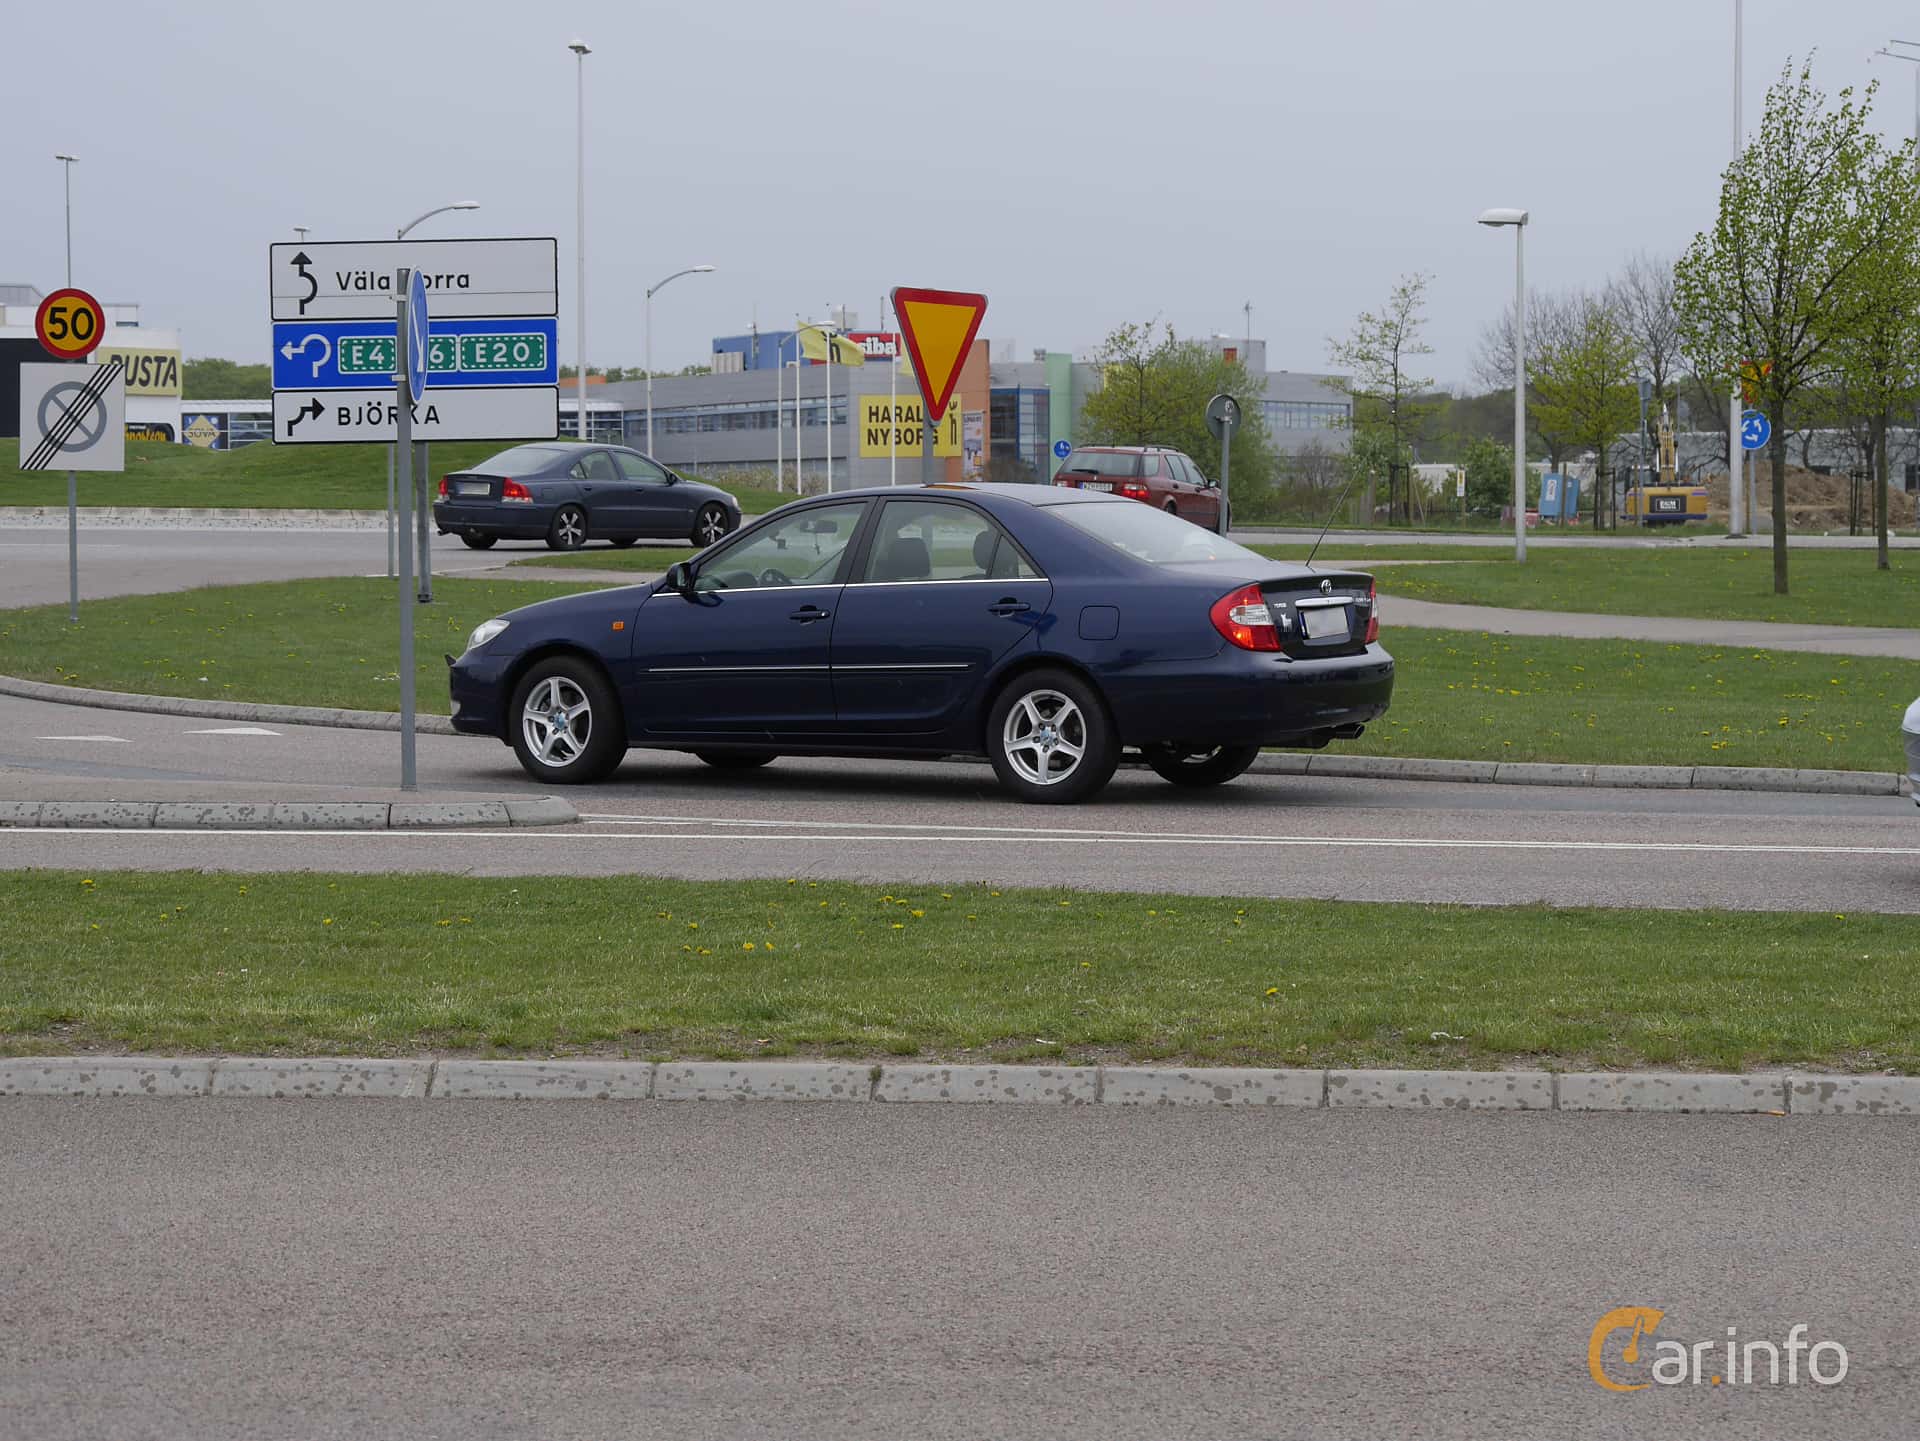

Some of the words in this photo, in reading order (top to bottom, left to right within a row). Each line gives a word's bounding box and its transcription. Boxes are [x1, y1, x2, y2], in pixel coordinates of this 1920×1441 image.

[336, 271, 391, 291] Väla
[423, 273, 470, 289] orra
[48, 306, 94, 340] 50
[351, 345, 385, 365] E4
[475, 341, 531, 363] E20
[868, 405, 924, 423] HARAL
